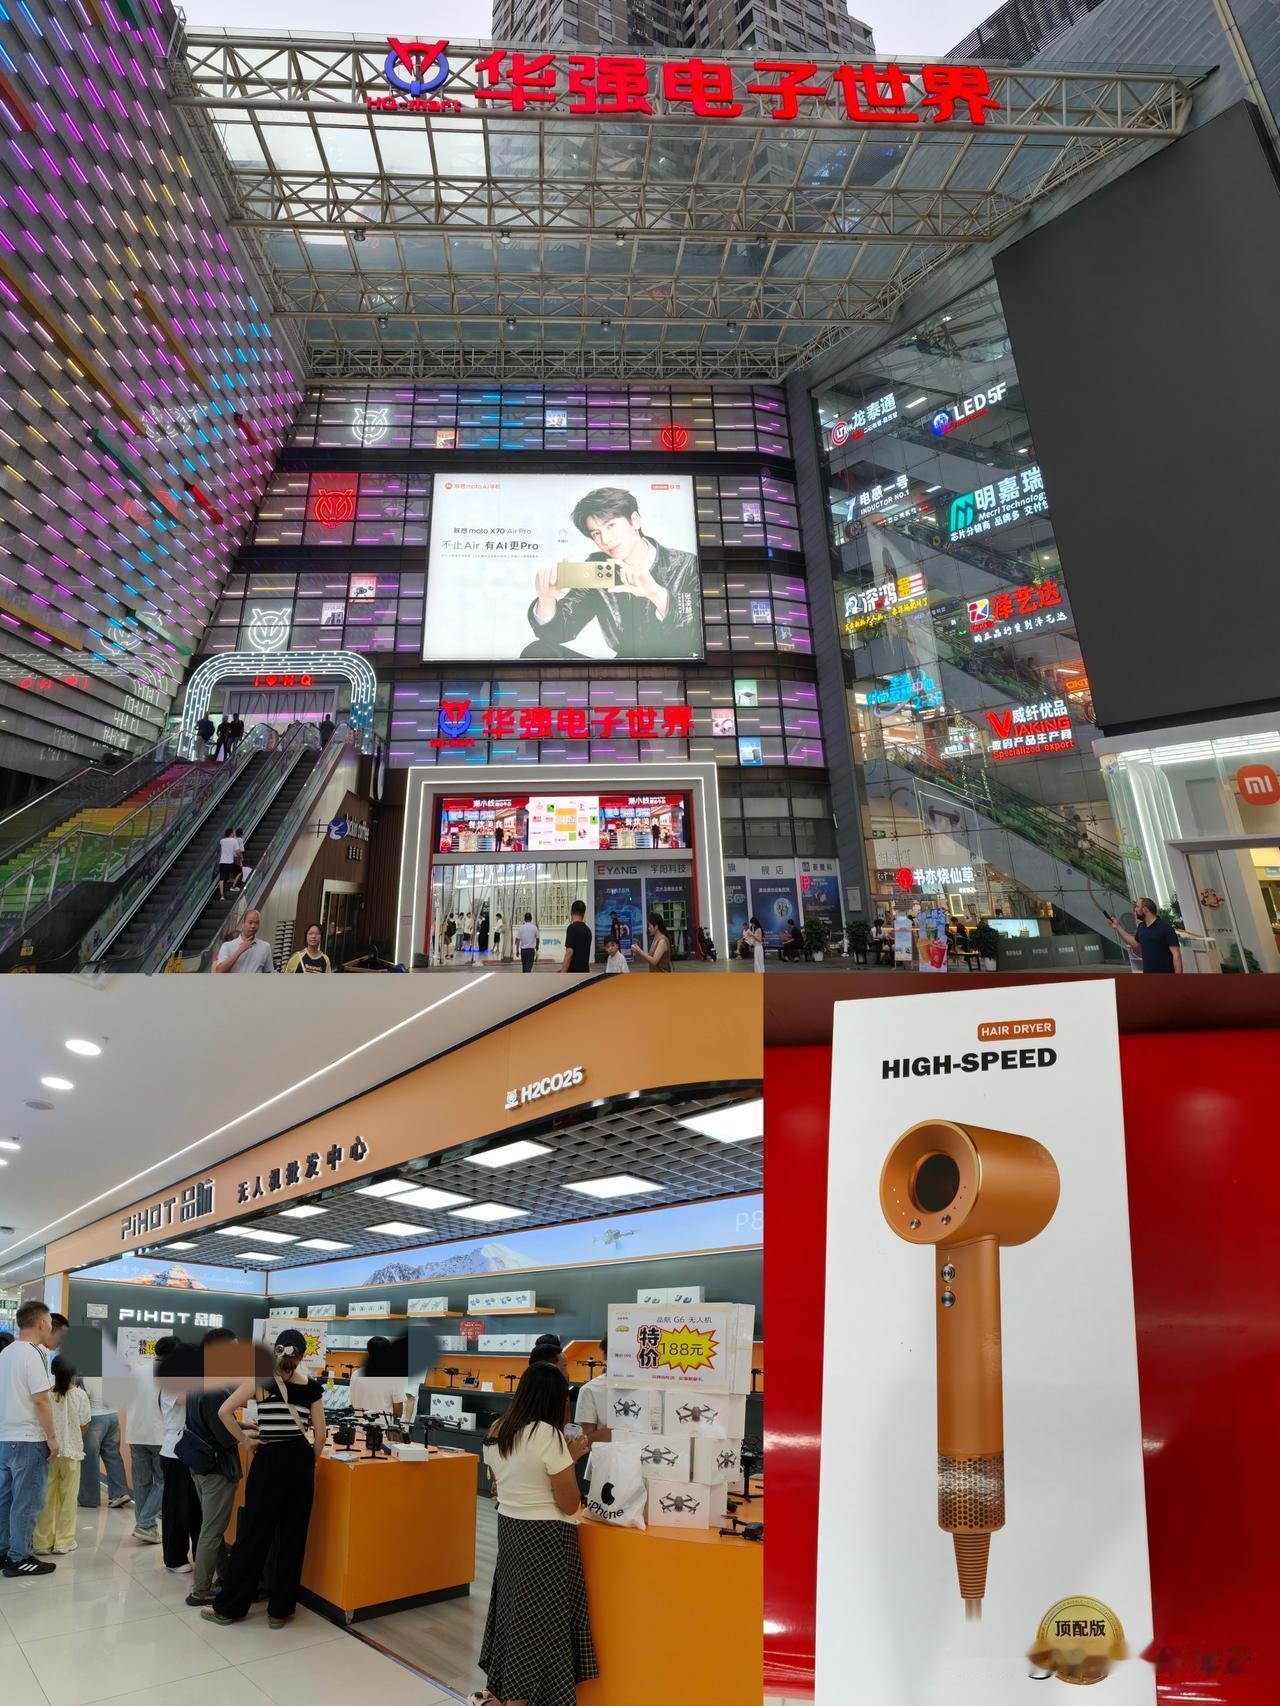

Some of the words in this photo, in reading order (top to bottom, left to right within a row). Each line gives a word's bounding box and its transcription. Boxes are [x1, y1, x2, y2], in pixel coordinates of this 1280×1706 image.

[475, 49, 1000, 125] 华强电子世界
[954, 393, 986, 420] LED
[987, 381, 1007, 404] 5F
[859, 474, 908, 506] 电感一号
[974, 465, 1044, 511] 明嘉瑞
[1001, 492, 1047, 513] Technolog
[482, 706, 694, 740] 华强电子世界
[1012, 699, 1068, 724] 威纤优品
[598, 865, 637, 875] EYANG
[913, 867, 975, 885] 书亦烧仙草
[981, 1026, 1009, 1037] HAIR
[1013, 1023, 1052, 1034] DRYER
[882, 1047, 1057, 1079] HIGH-SPEED
[689, 1316, 712, 1324] 无人机
[639, 1327, 660, 1367] 特价
[660, 1343, 704, 1356] 188元
[1055, 1619, 1106, 1637] 顶配版
